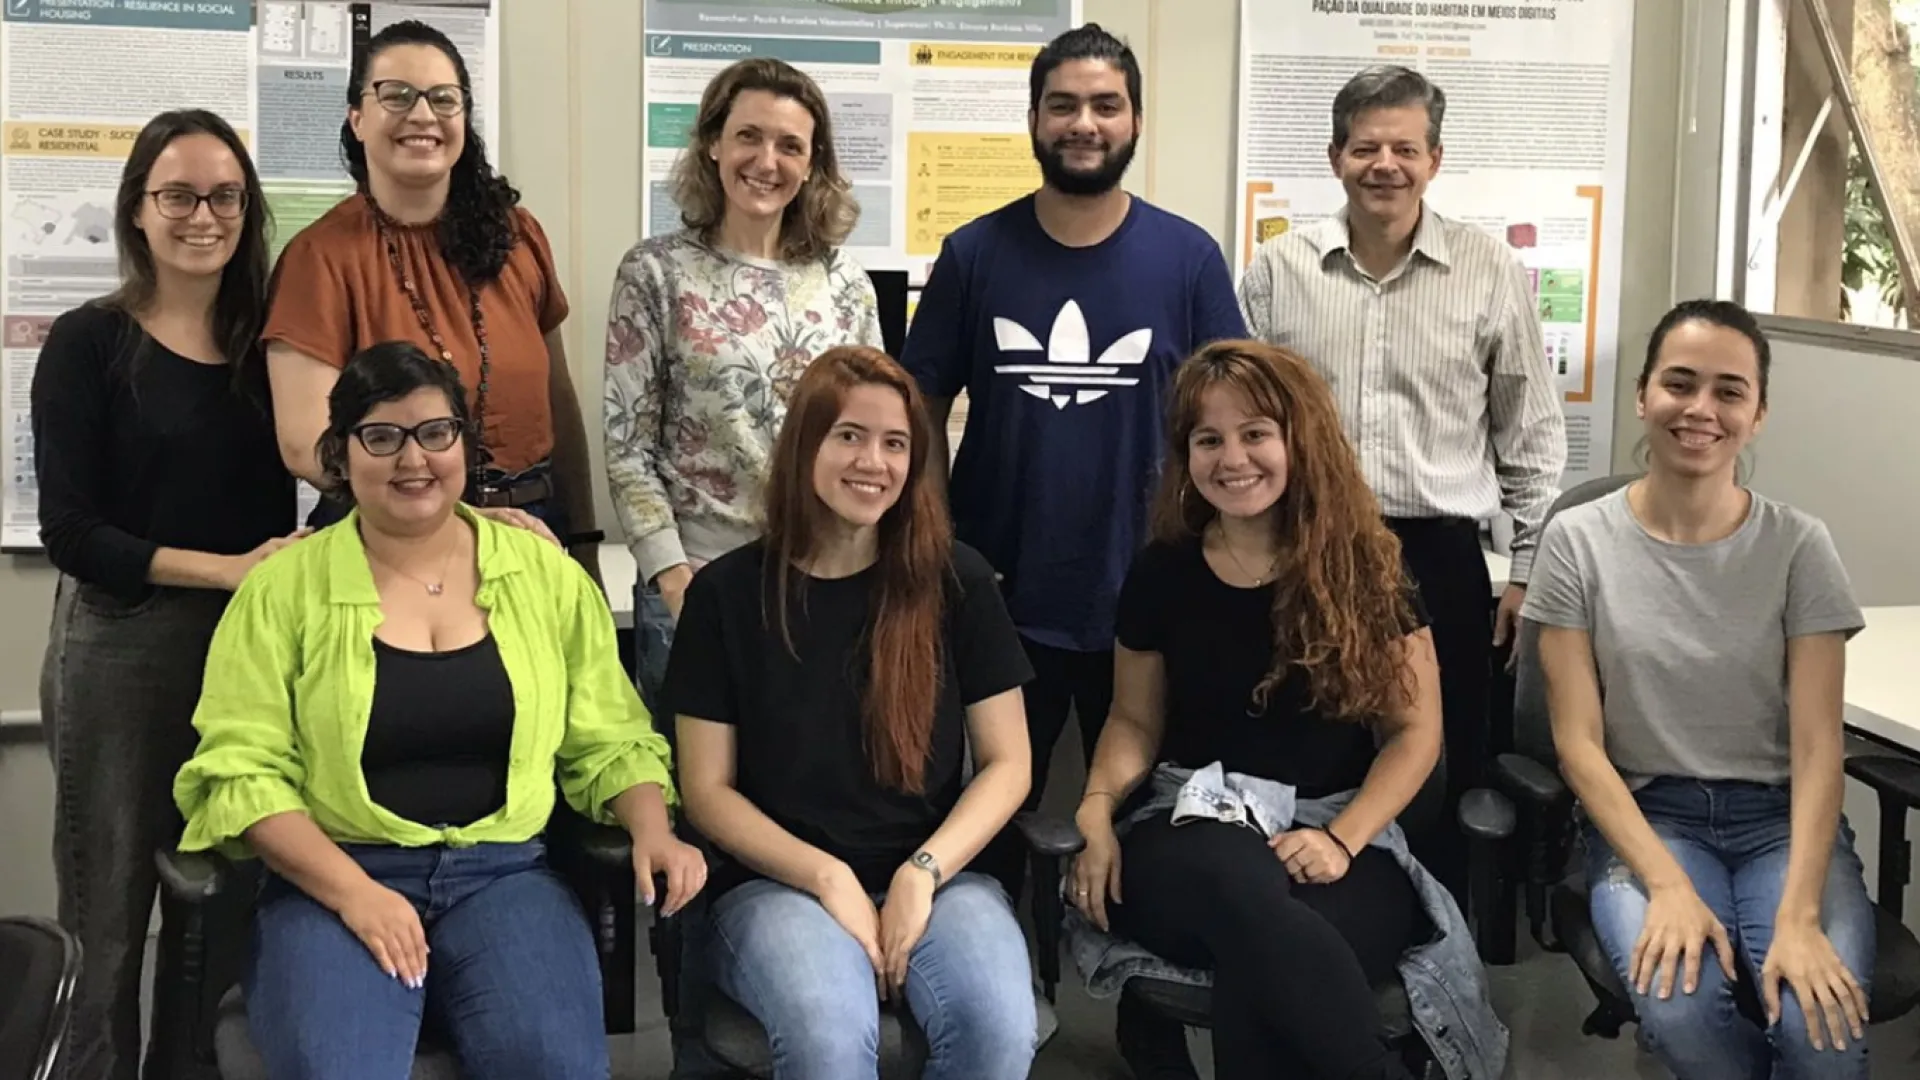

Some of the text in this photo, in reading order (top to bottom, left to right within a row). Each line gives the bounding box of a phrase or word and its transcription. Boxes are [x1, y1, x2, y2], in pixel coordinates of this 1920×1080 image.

[39, 0, 115, 8] PRESENTATION
[124, 1, 180, 12] RESILIENCE
[182, 3, 195, 13] IN
[197, 3, 235, 15] SOCIAL
[1346, 0, 1359, 13] DA
[1360, 1, 1413, 14] QUALIDADE
[1415, 3, 1428, 15] DO
[1430, 4, 1469, 16] HABITAR
[1471, 5, 1486, 17] EM
[1487, 6, 1517, 18] MEIOS
[1518, 7, 1556, 19] DIGITAIS
[39, 8, 92, 20] HOUSING
[682, 42, 752, 53] PRESENTATION
[937, 51, 996, 61] ENGAGEMENT
[998, 51, 1014, 61] FOR
[284, 70, 325, 81] RESULTS
[38, 127, 64, 138] CASE
[67, 128, 101, 139] STUDY
[38, 140, 100, 151] RESIDENTIAL
